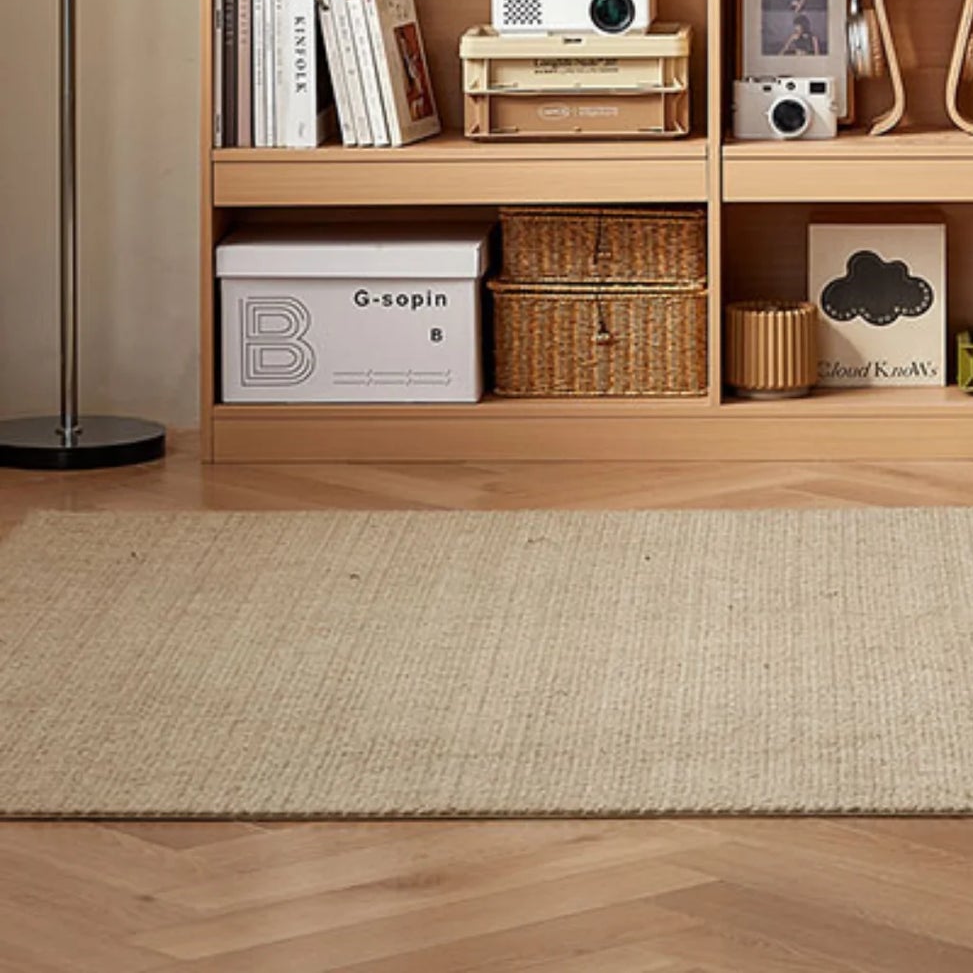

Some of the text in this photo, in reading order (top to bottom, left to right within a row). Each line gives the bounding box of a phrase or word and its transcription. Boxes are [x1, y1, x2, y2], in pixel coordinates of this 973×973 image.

[294, 16, 308, 94] KINFOLK
[353, 289, 447, 310] G-sopin
[238, 296, 316, 387] B
[429, 327, 443, 342] B
